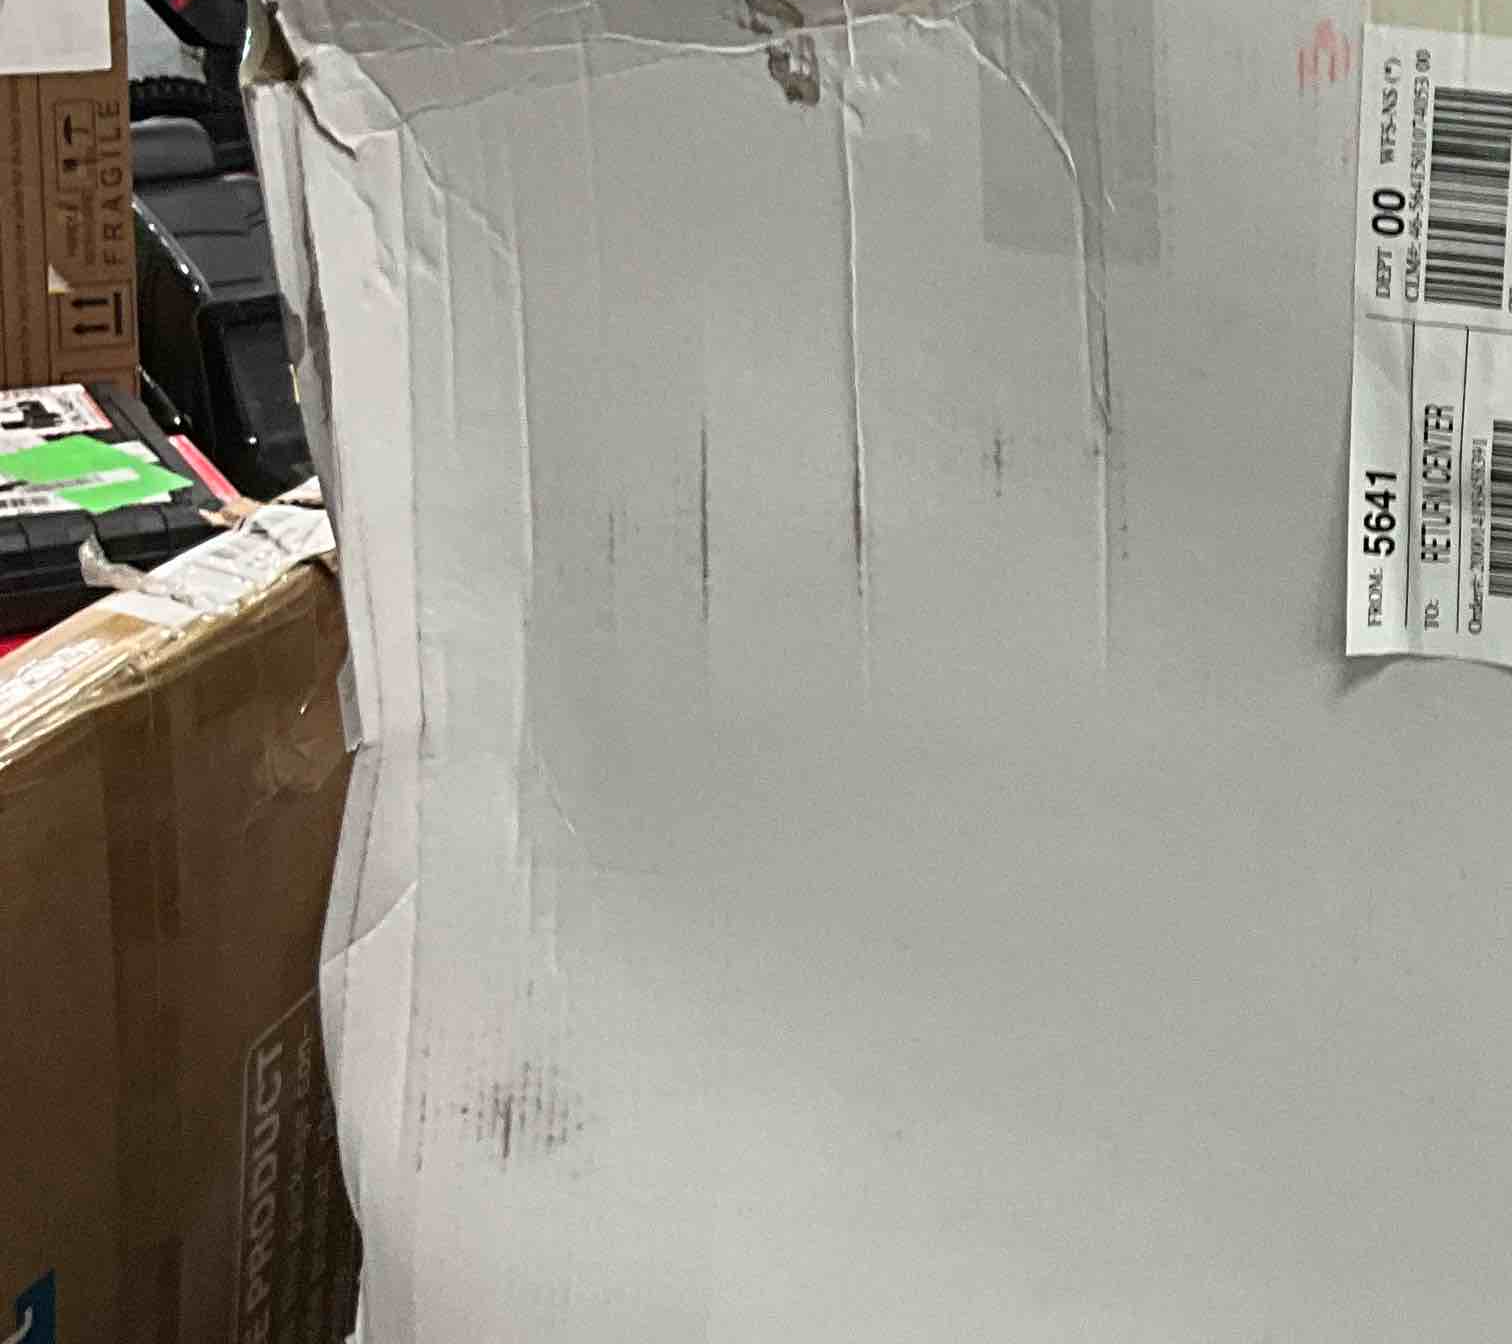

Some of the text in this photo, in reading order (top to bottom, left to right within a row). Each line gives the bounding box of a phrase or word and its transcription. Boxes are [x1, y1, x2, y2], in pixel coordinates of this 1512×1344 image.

[97, 100, 123, 267] FRAGILE
[1371, 189, 1406, 237] 00
[1422, 403, 1454, 484] CENTER
[1362, 470, 1398, 557] 5641
[1420, 485, 1452, 564] RETURN
[245, 1041, 285, 1311] PRODUCT
